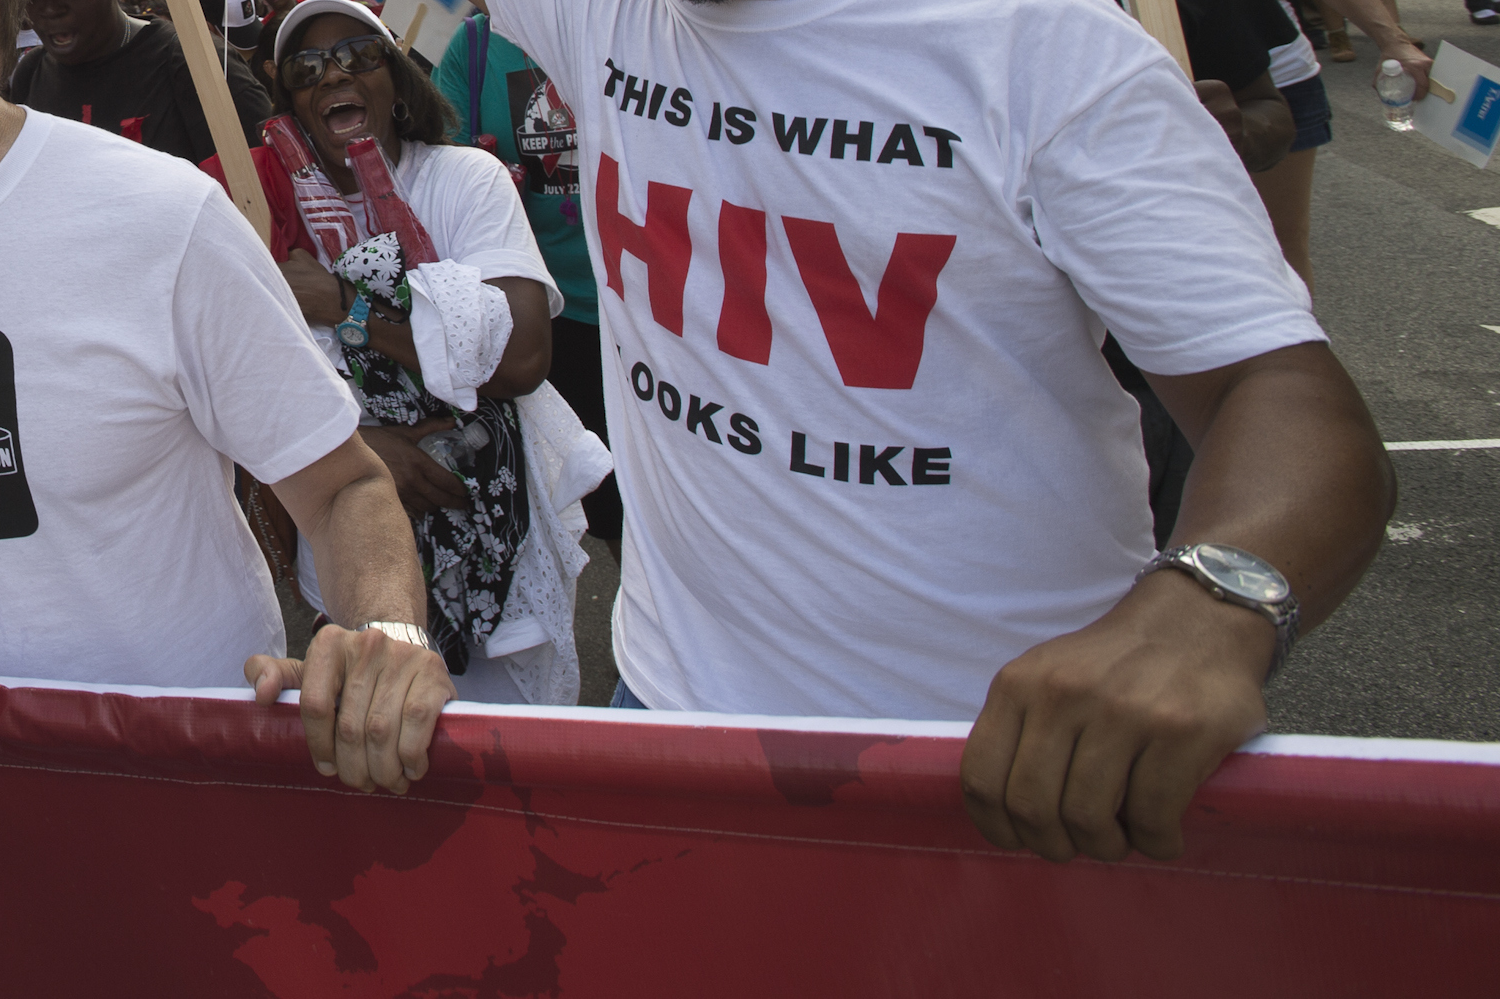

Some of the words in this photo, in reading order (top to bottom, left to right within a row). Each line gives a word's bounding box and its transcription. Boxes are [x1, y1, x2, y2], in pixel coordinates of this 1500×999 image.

[522, 136, 548, 151] KEEP
[550, 136, 565, 149] the
[604, 57, 694, 128] THIS
[708, 102, 757, 145] IS
[772, 111, 963, 169] WHAT
[544, 183, 565, 195] JULY
[595, 150, 958, 390] HIV
[616, 344, 763, 456] OOKS
[790, 430, 953, 487] LIKE
